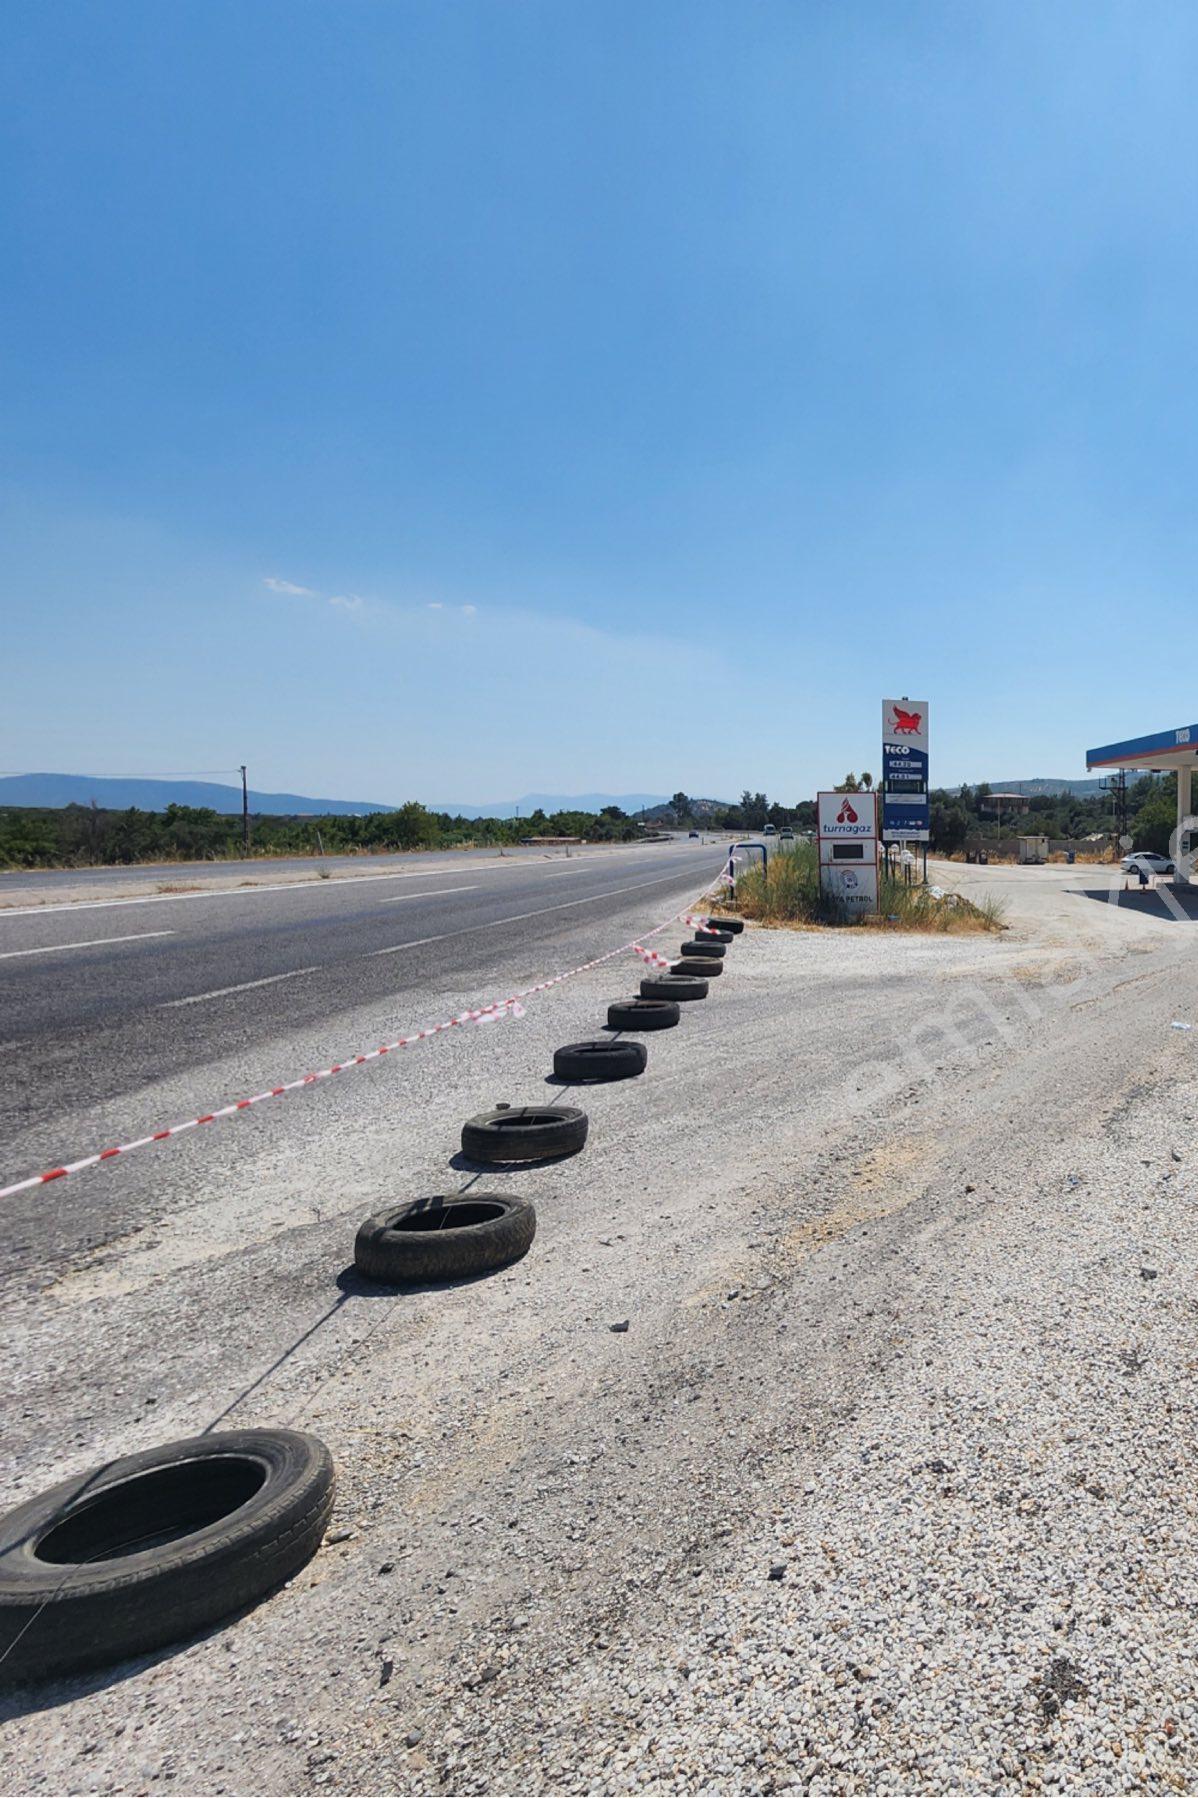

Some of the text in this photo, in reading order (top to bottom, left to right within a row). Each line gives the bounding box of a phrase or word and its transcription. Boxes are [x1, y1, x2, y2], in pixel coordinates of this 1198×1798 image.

[884, 745, 910, 755] TECO
[823, 823, 872, 835] turnagaz
[846, 895, 872, 903] PETROL
